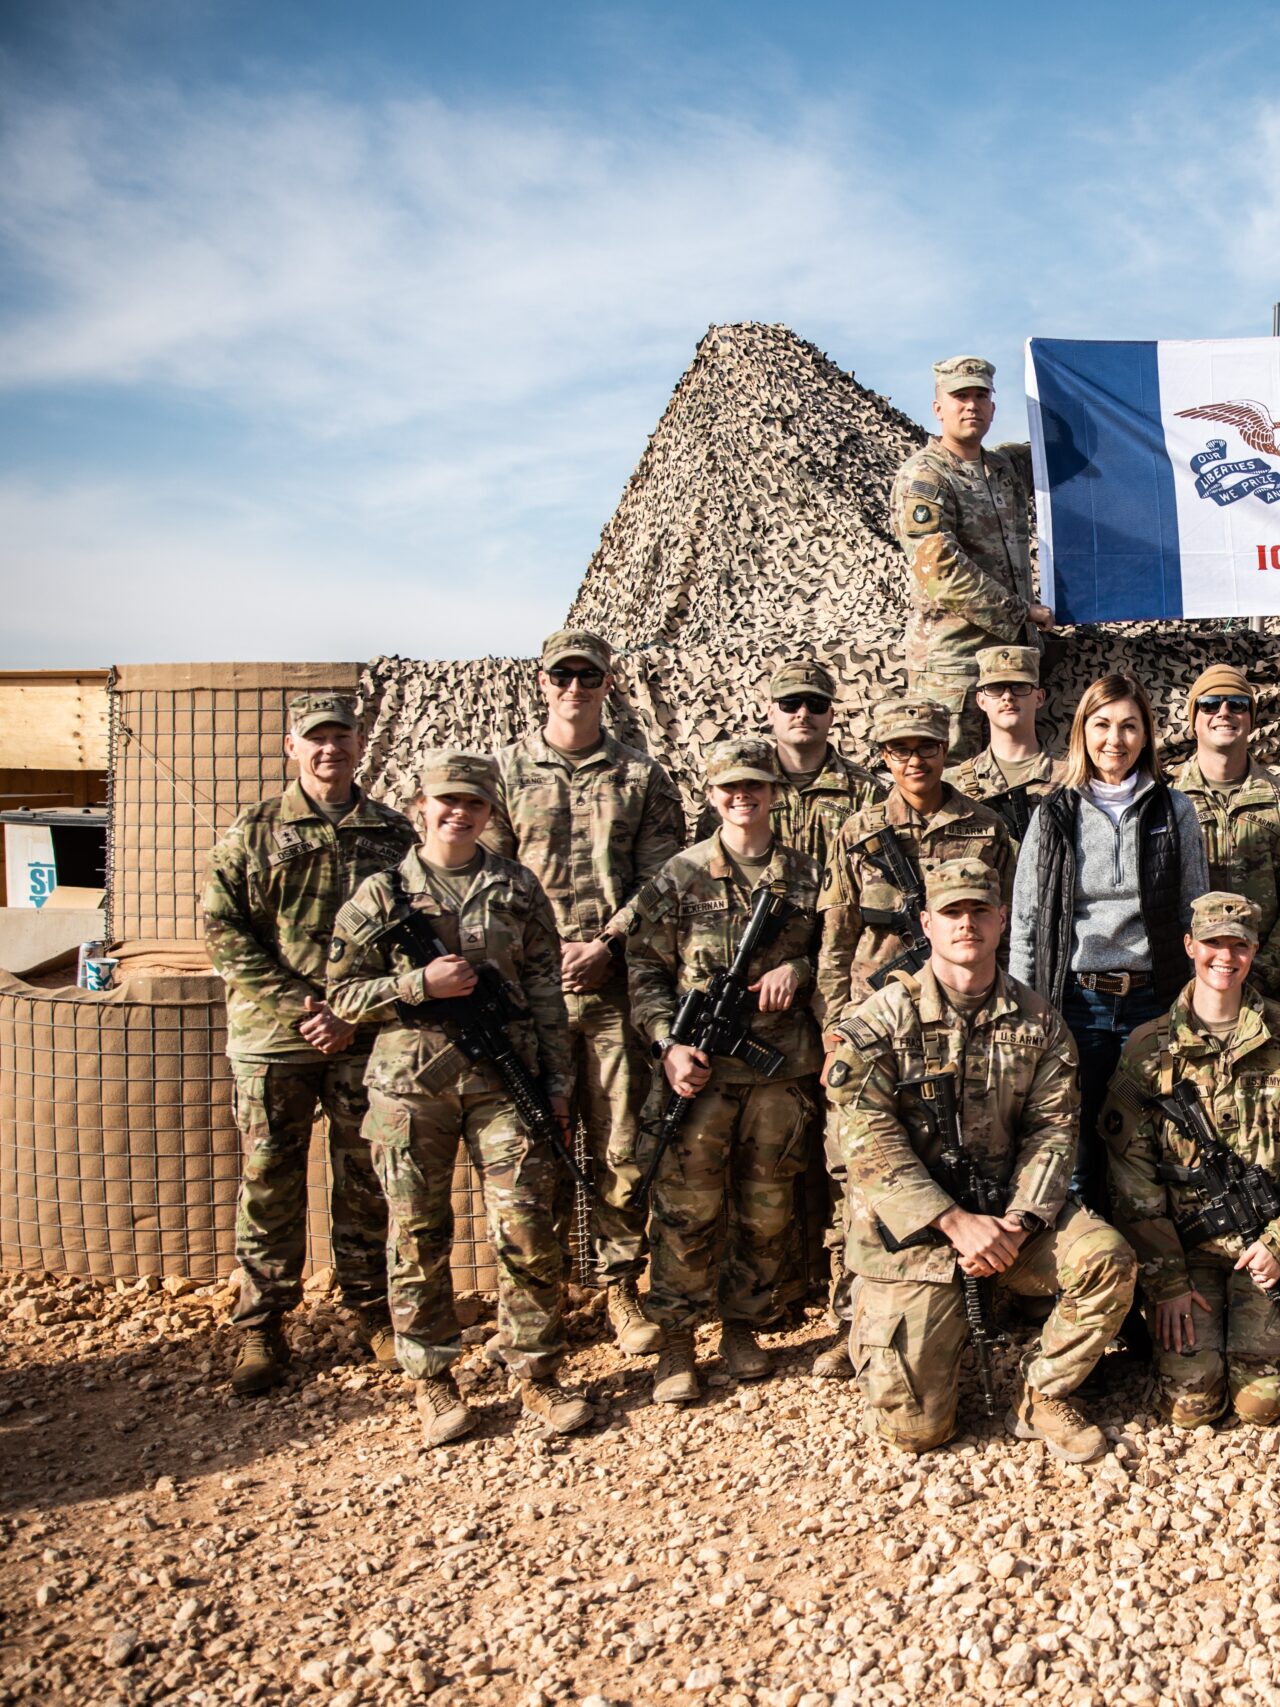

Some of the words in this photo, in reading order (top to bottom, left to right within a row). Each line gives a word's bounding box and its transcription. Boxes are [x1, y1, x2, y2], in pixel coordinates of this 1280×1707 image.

[1197, 452, 1222, 463] OUR
[1200, 461, 1256, 489] LIBERTIES
[1219, 489, 1238, 502] WE
[1241, 474, 1276, 491] PRIZE
[1258, 817, 1275, 829] ARMY
[965, 827, 989, 835] ARMY
[278, 841, 314, 860] OSBORN
[379, 847, 402, 862] ARMY
[1000, 1031, 1018, 1043] U.S.
[1019, 1034, 1045, 1047] ARMY
